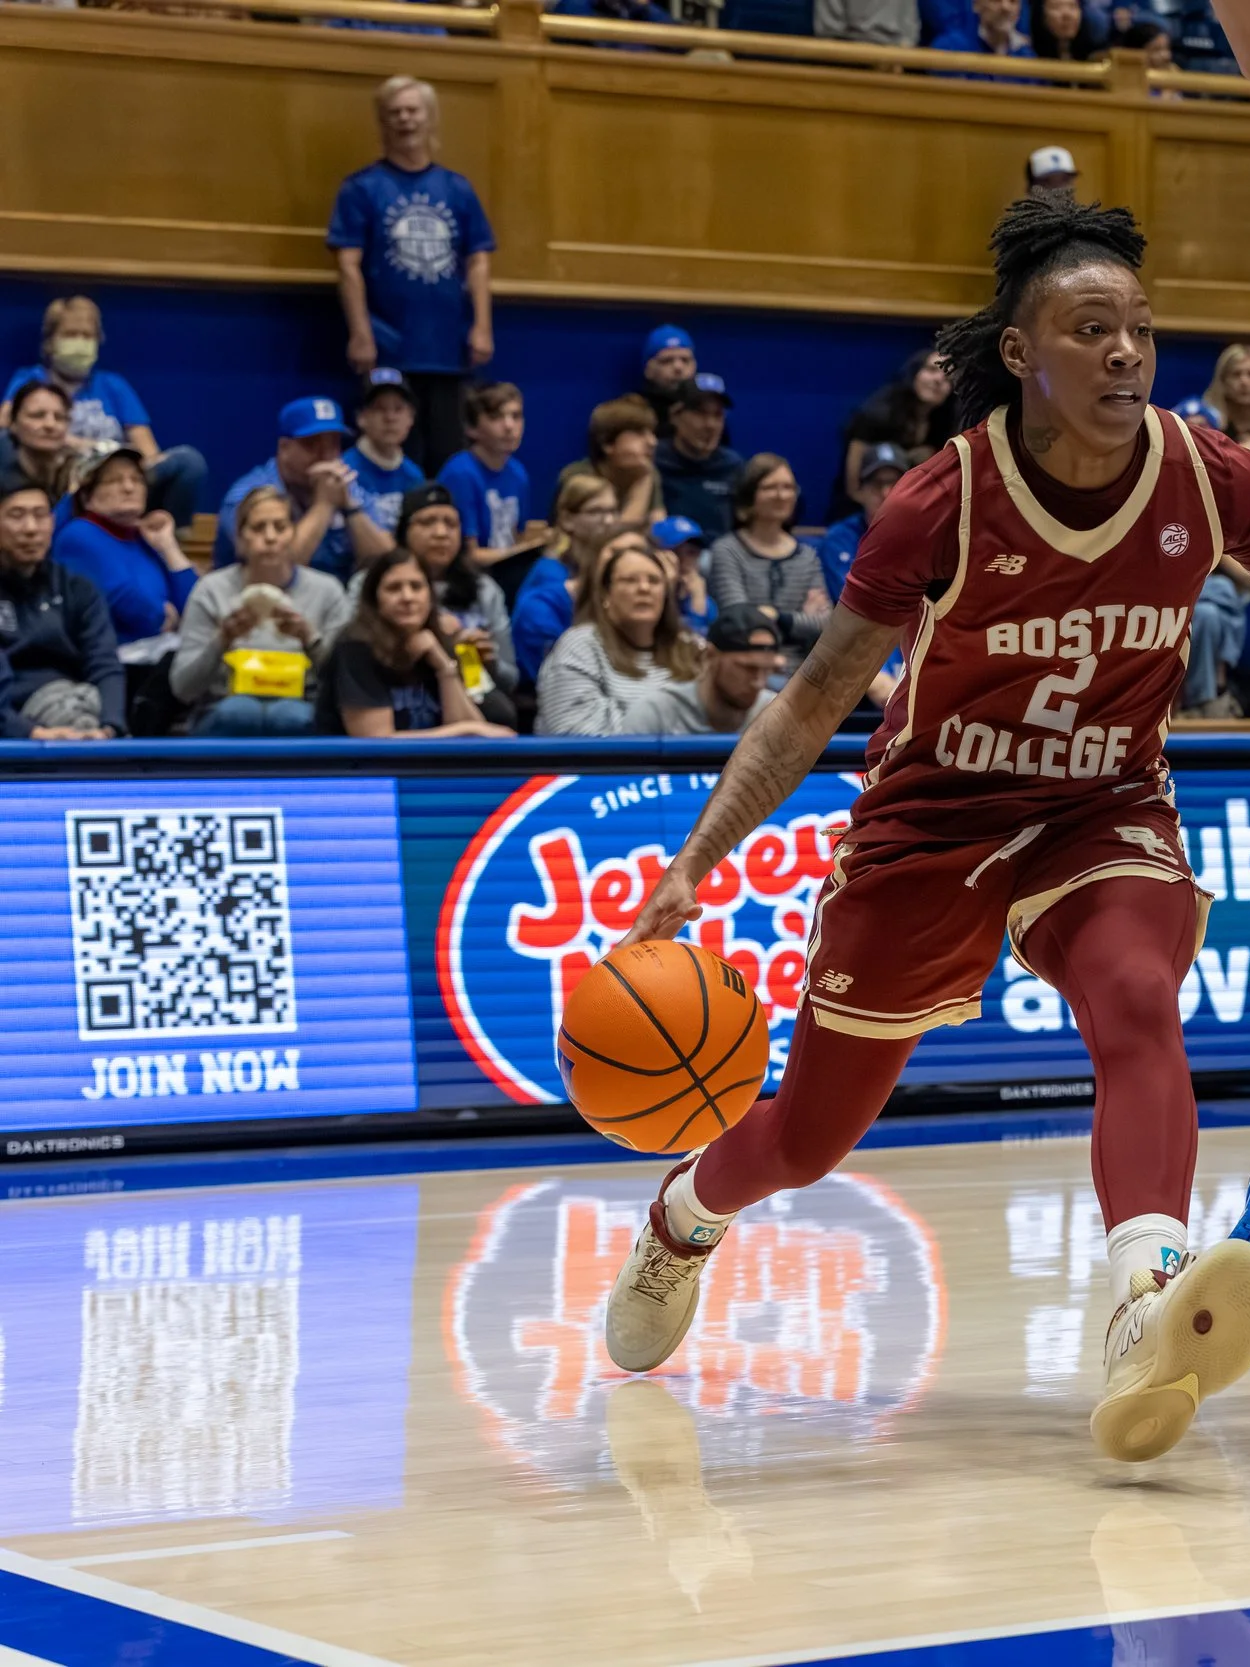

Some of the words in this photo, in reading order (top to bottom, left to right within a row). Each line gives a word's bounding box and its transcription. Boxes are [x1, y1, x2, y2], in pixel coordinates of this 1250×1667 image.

[986, 604, 1189, 659] BOSTON
[1022, 653, 1099, 737] 2
[935, 713, 1133, 780] COLLEGE
[590, 775, 673, 819] SINCE
[81, 1054, 188, 1100] JOIN
[200, 1049, 300, 1094] NOW
[6, 1135, 125, 1155] DAKTRONICS
